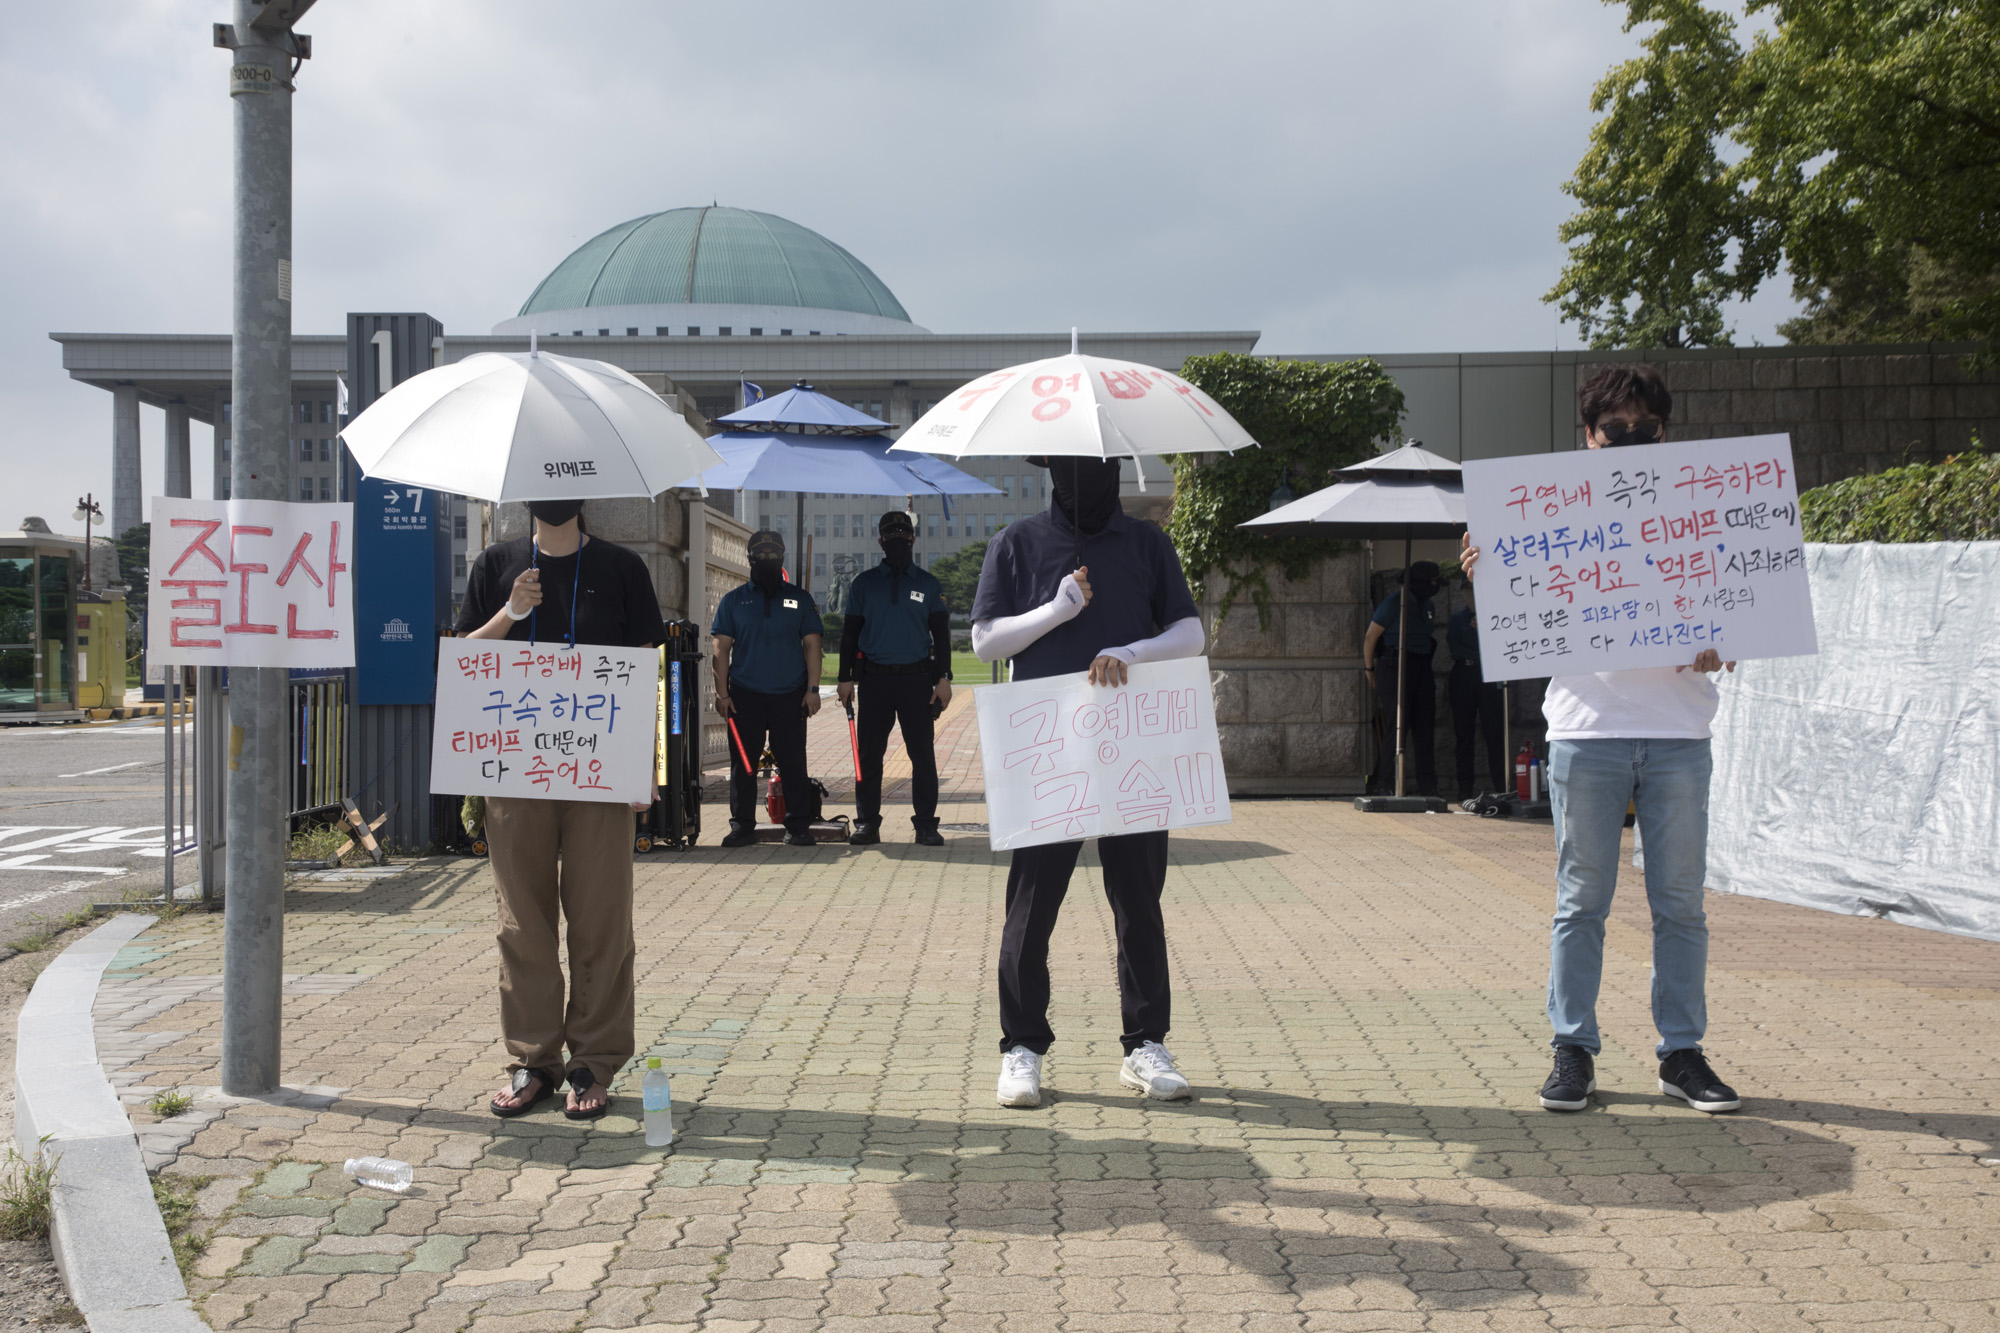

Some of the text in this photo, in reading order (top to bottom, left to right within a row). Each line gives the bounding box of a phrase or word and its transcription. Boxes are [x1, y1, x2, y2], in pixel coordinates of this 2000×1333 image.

[370, 330, 393, 393] 1
[543, 460, 597, 478] 위메프
[1506, 458, 1787, 520] 구영배 즉각 구속하라
[406, 489, 423, 513] 7
[1493, 501, 1796, 567] 살려주세요 티메프 때문에
[160, 518, 347, 648] 줄도산
[1510, 575, 1540, 598] 다
[1547, 560, 1640, 603] 죽어요
[1724, 546, 1806, 578] 사죄하라
[1490, 611, 1528, 632] 20년
[1539, 608, 1570, 629] 넘은
[1674, 594, 1696, 620] 한
[1702, 585, 1755, 611] 사람의
[457, 650, 636, 686] 먹튀 구영배 즉각
[1503, 636, 1573, 664] 농간으로
[1590, 634, 1615, 652] 다
[482, 688, 621, 733] 구속하라
[1003, 688, 1198, 776] 구영배
[452, 729, 598, 756] 티메프 때문에
[482, 755, 613, 792] 다 죽어요
